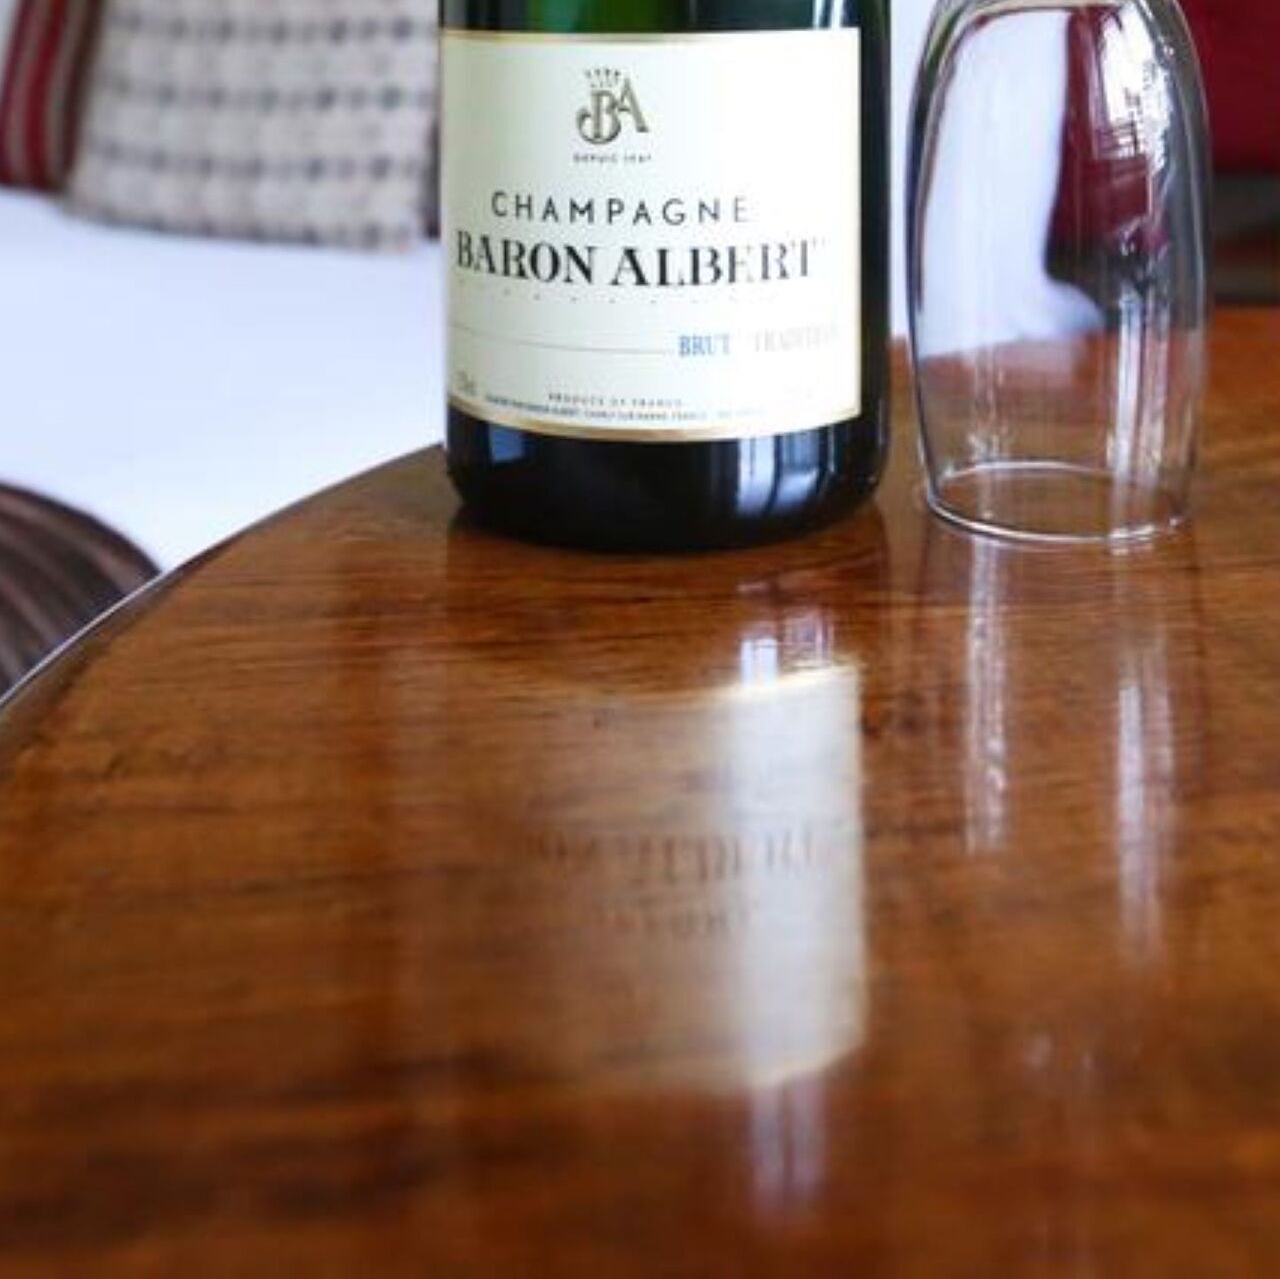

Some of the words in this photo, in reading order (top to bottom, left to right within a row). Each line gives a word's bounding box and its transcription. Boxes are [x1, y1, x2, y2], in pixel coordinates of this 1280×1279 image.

[491, 191, 749, 225] CHAMPAGNE
[456, 229, 597, 284] BARON
[610, 235, 826, 287] ALBERT
[678, 332, 732, 358] BRUT
